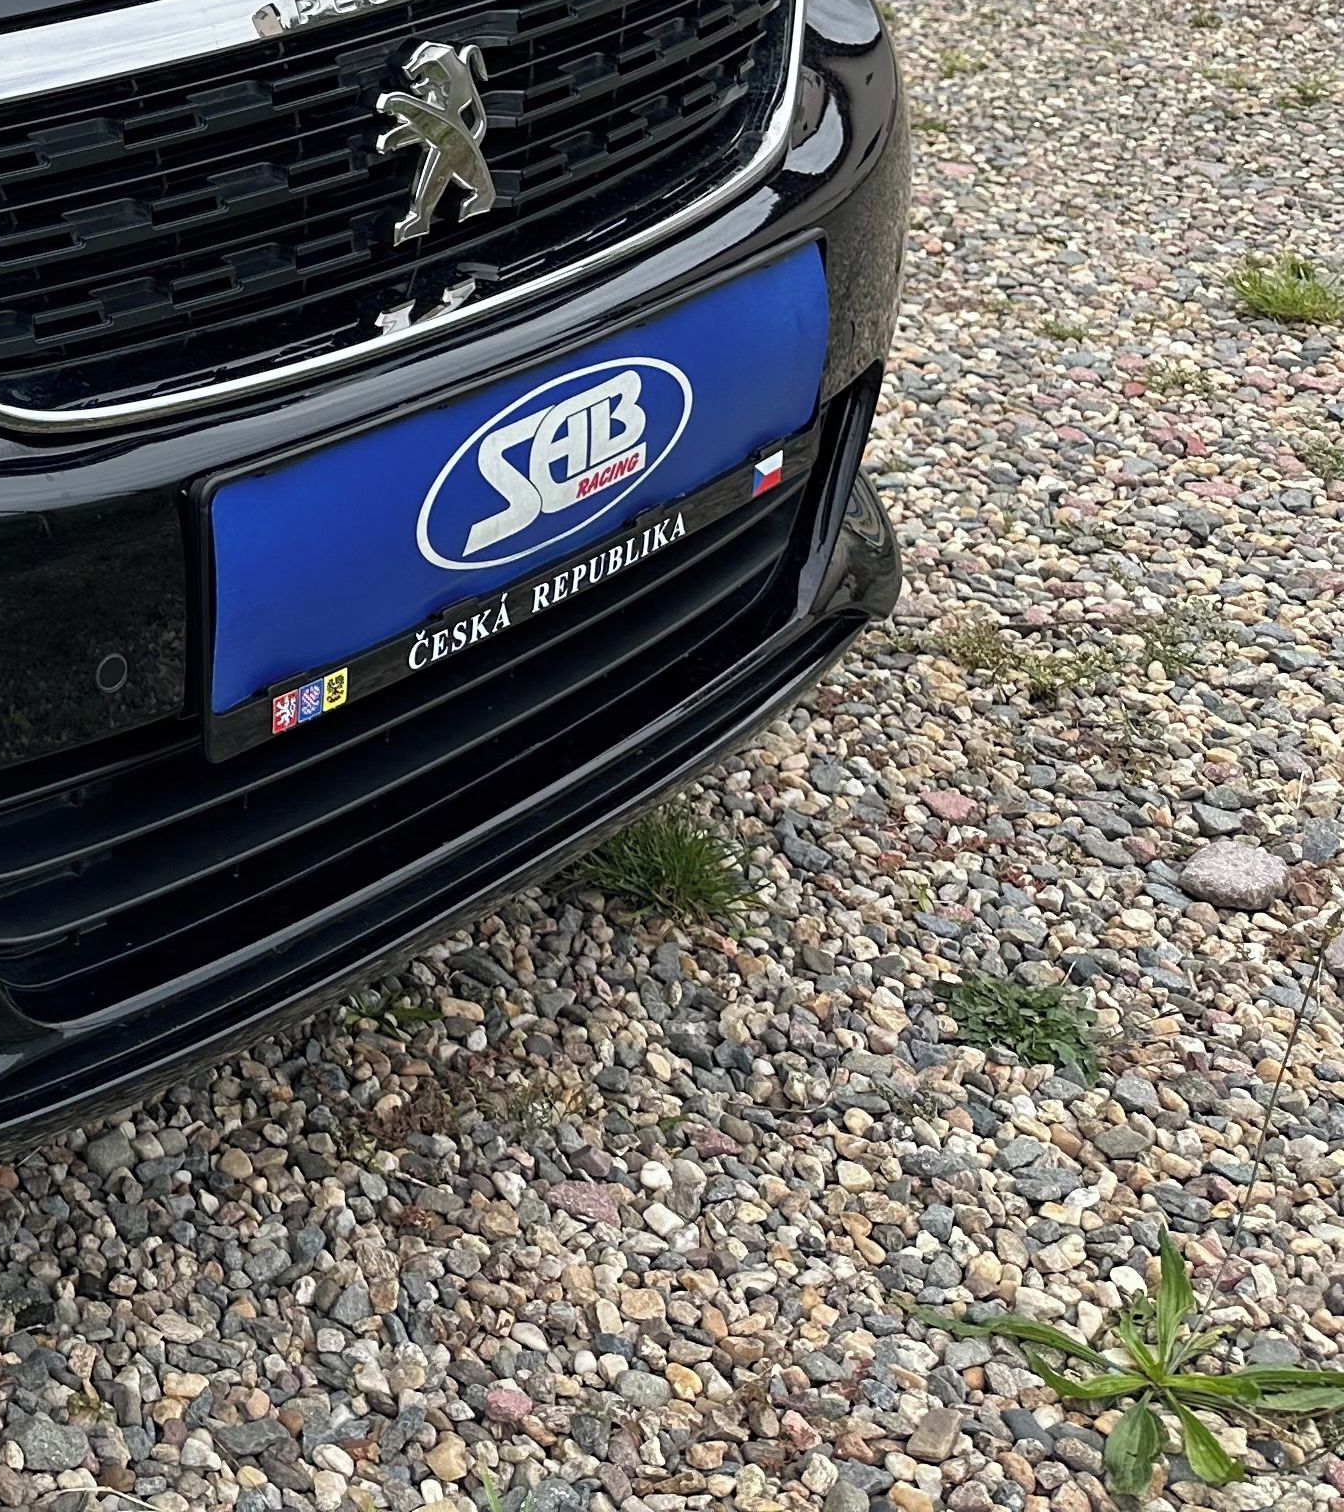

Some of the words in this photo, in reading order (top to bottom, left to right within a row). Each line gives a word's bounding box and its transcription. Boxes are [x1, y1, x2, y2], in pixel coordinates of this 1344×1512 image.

[462, 369, 647, 557] SAB
[575, 452, 640, 500] RACING
[408, 592, 512, 670] ČESKÁ
[531, 511, 687, 614] REPUBLIKA
